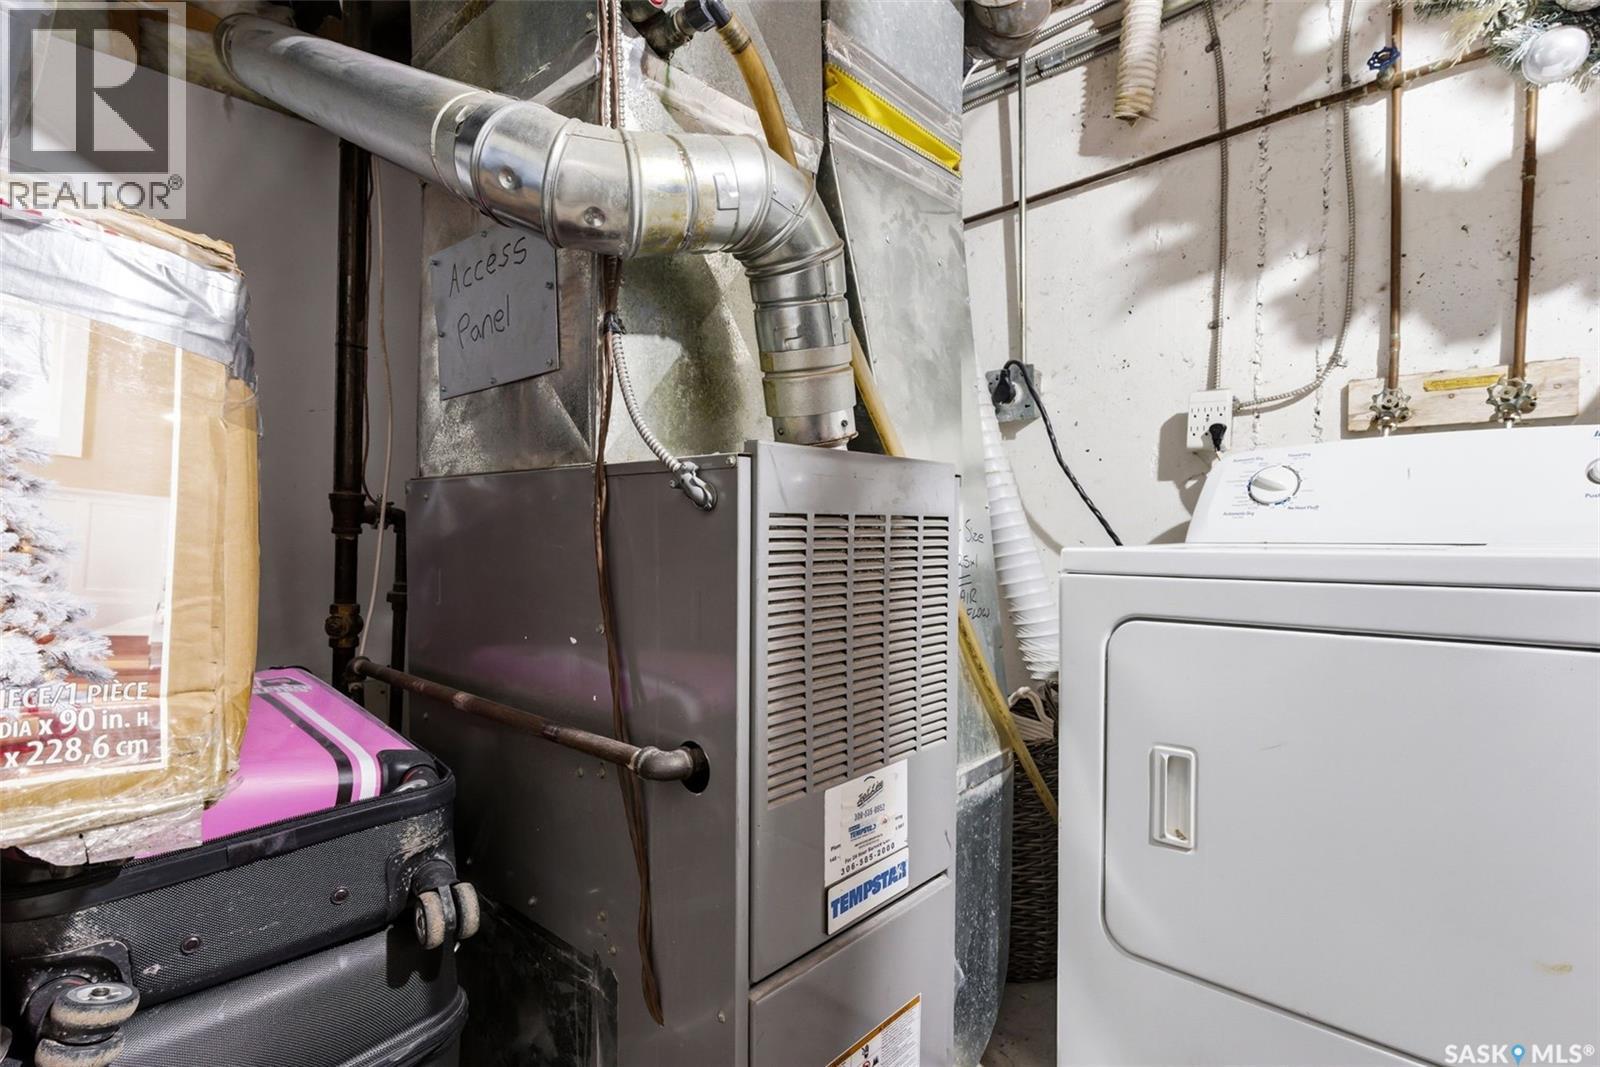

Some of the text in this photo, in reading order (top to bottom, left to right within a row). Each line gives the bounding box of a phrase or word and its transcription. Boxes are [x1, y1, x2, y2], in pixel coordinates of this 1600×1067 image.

[449, 236, 528, 298] Access
[457, 294, 511, 350] Panel
[964, 518, 985, 544] Size
[87, 680, 149, 703] PIÈCE
[38, 718, 54, 736] x
[58, 707, 96, 734] 90
[101, 709, 131, 730] in.
[136, 711, 149, 727] H
[3, 734, 149, 769] x 228,6 cm
[830, 860, 908, 920] TEMPSTAR
